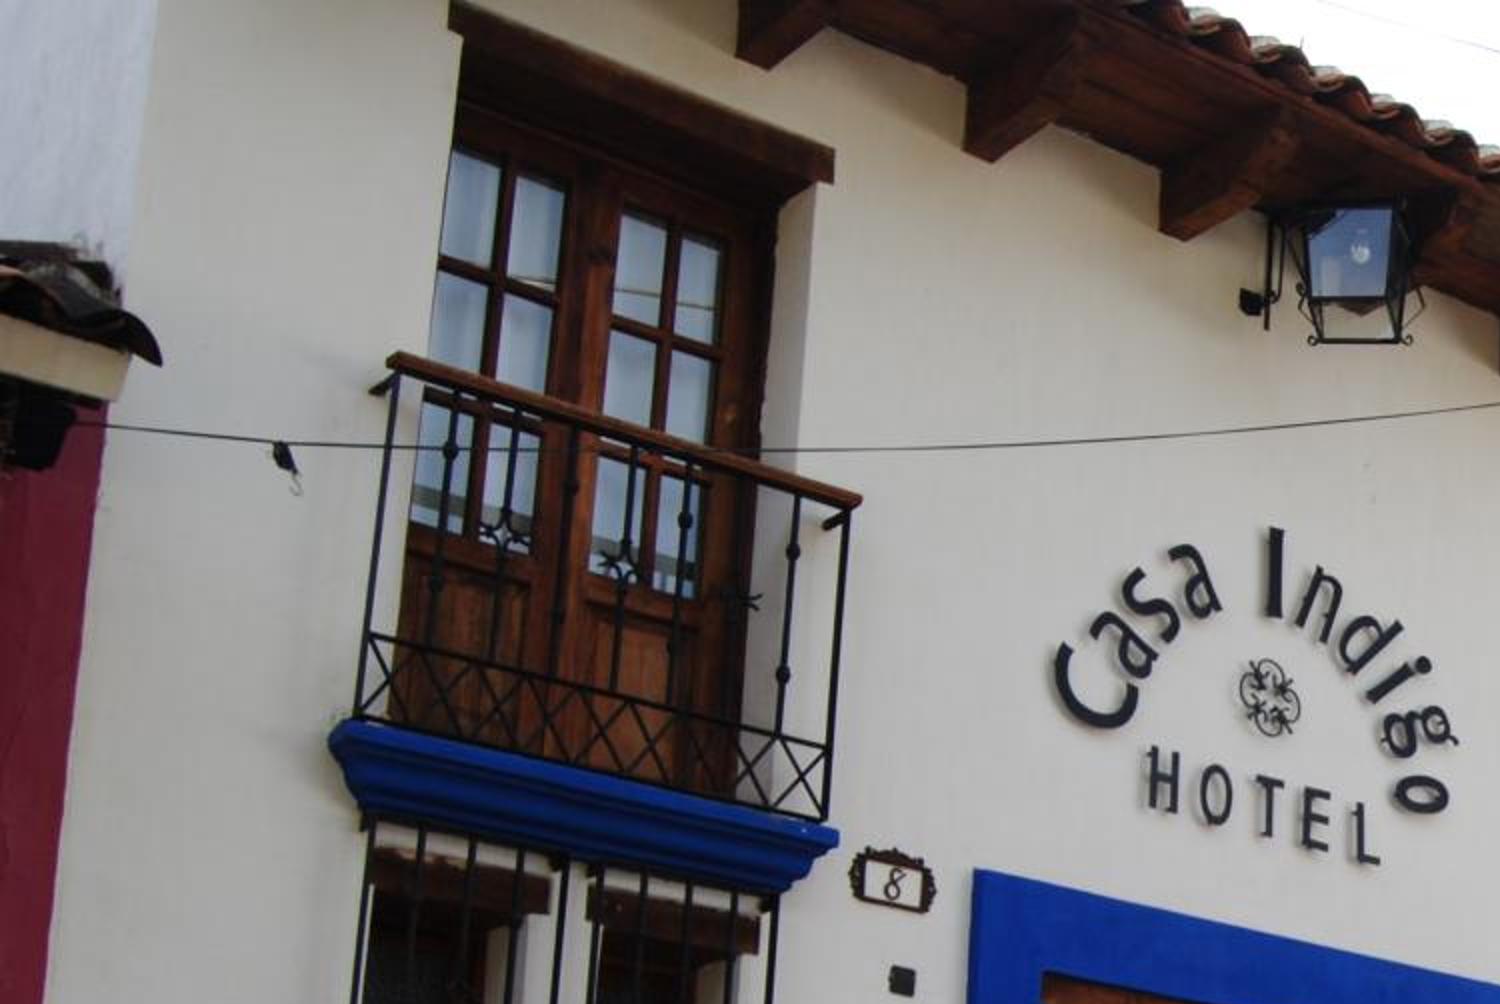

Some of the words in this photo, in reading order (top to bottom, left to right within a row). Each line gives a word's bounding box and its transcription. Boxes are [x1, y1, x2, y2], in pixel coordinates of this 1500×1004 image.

[1054, 543, 1222, 729] Casa
[1263, 526, 1459, 814] Indigo
[1147, 744, 1381, 866] HOTEL
[884, 867, 906, 901] 8
